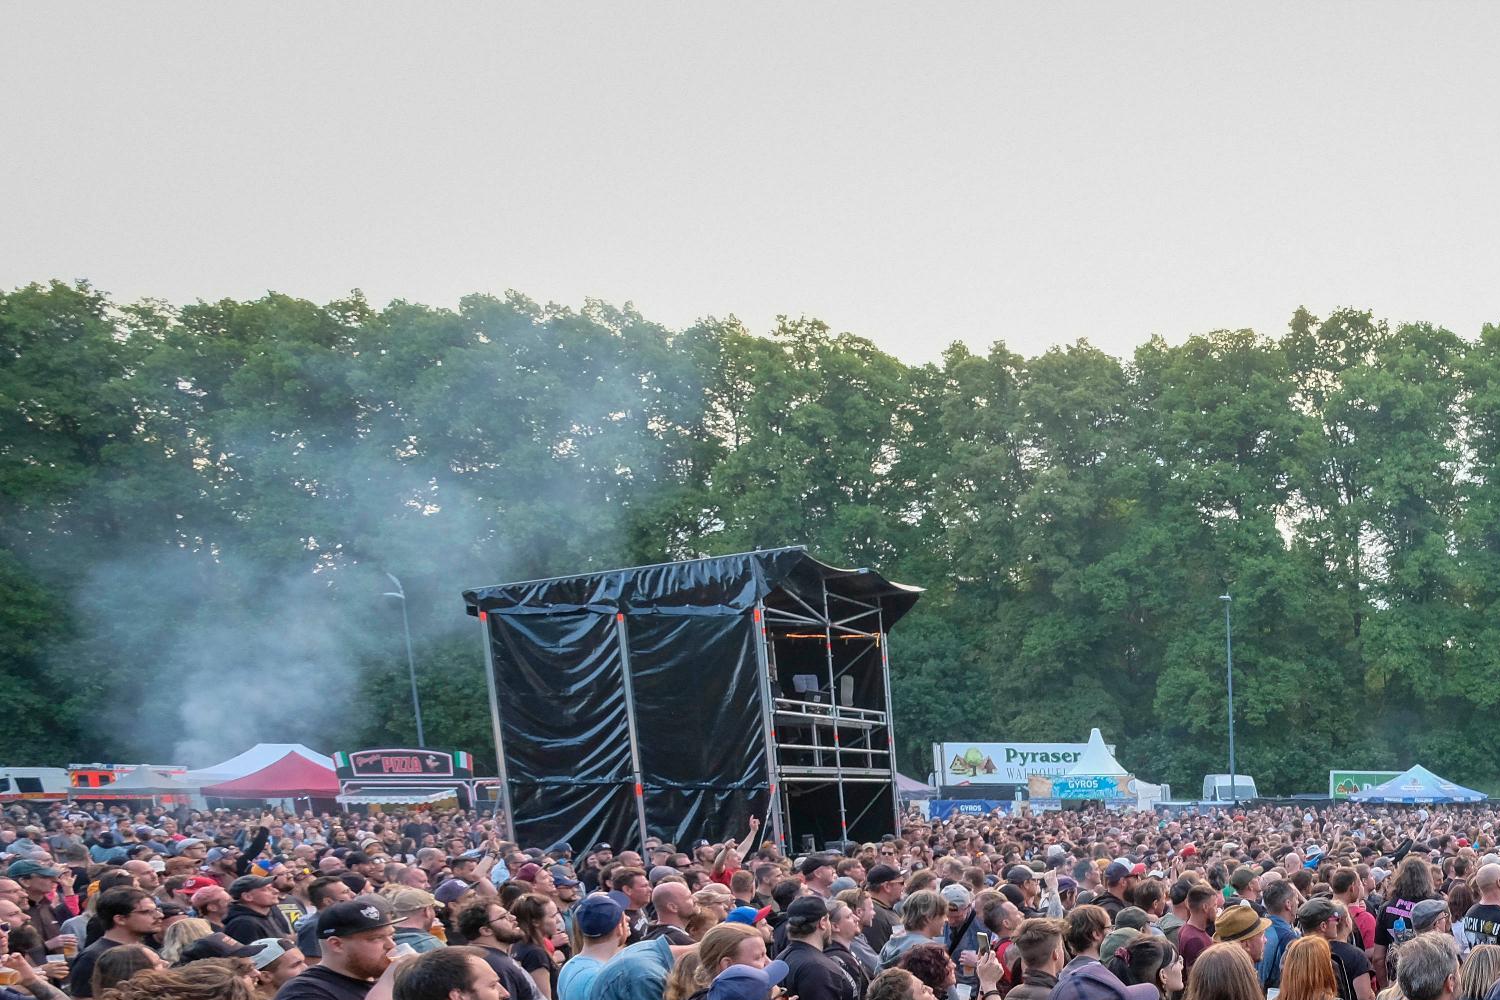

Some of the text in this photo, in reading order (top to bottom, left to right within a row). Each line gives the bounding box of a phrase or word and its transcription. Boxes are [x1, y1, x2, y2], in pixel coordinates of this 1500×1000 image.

[1004, 747, 1082, 767] Pyraser
[381, 755, 422, 773] PIZZA
[1068, 780, 1099, 789] GYROS
[960, 804, 982, 812] GYROS
